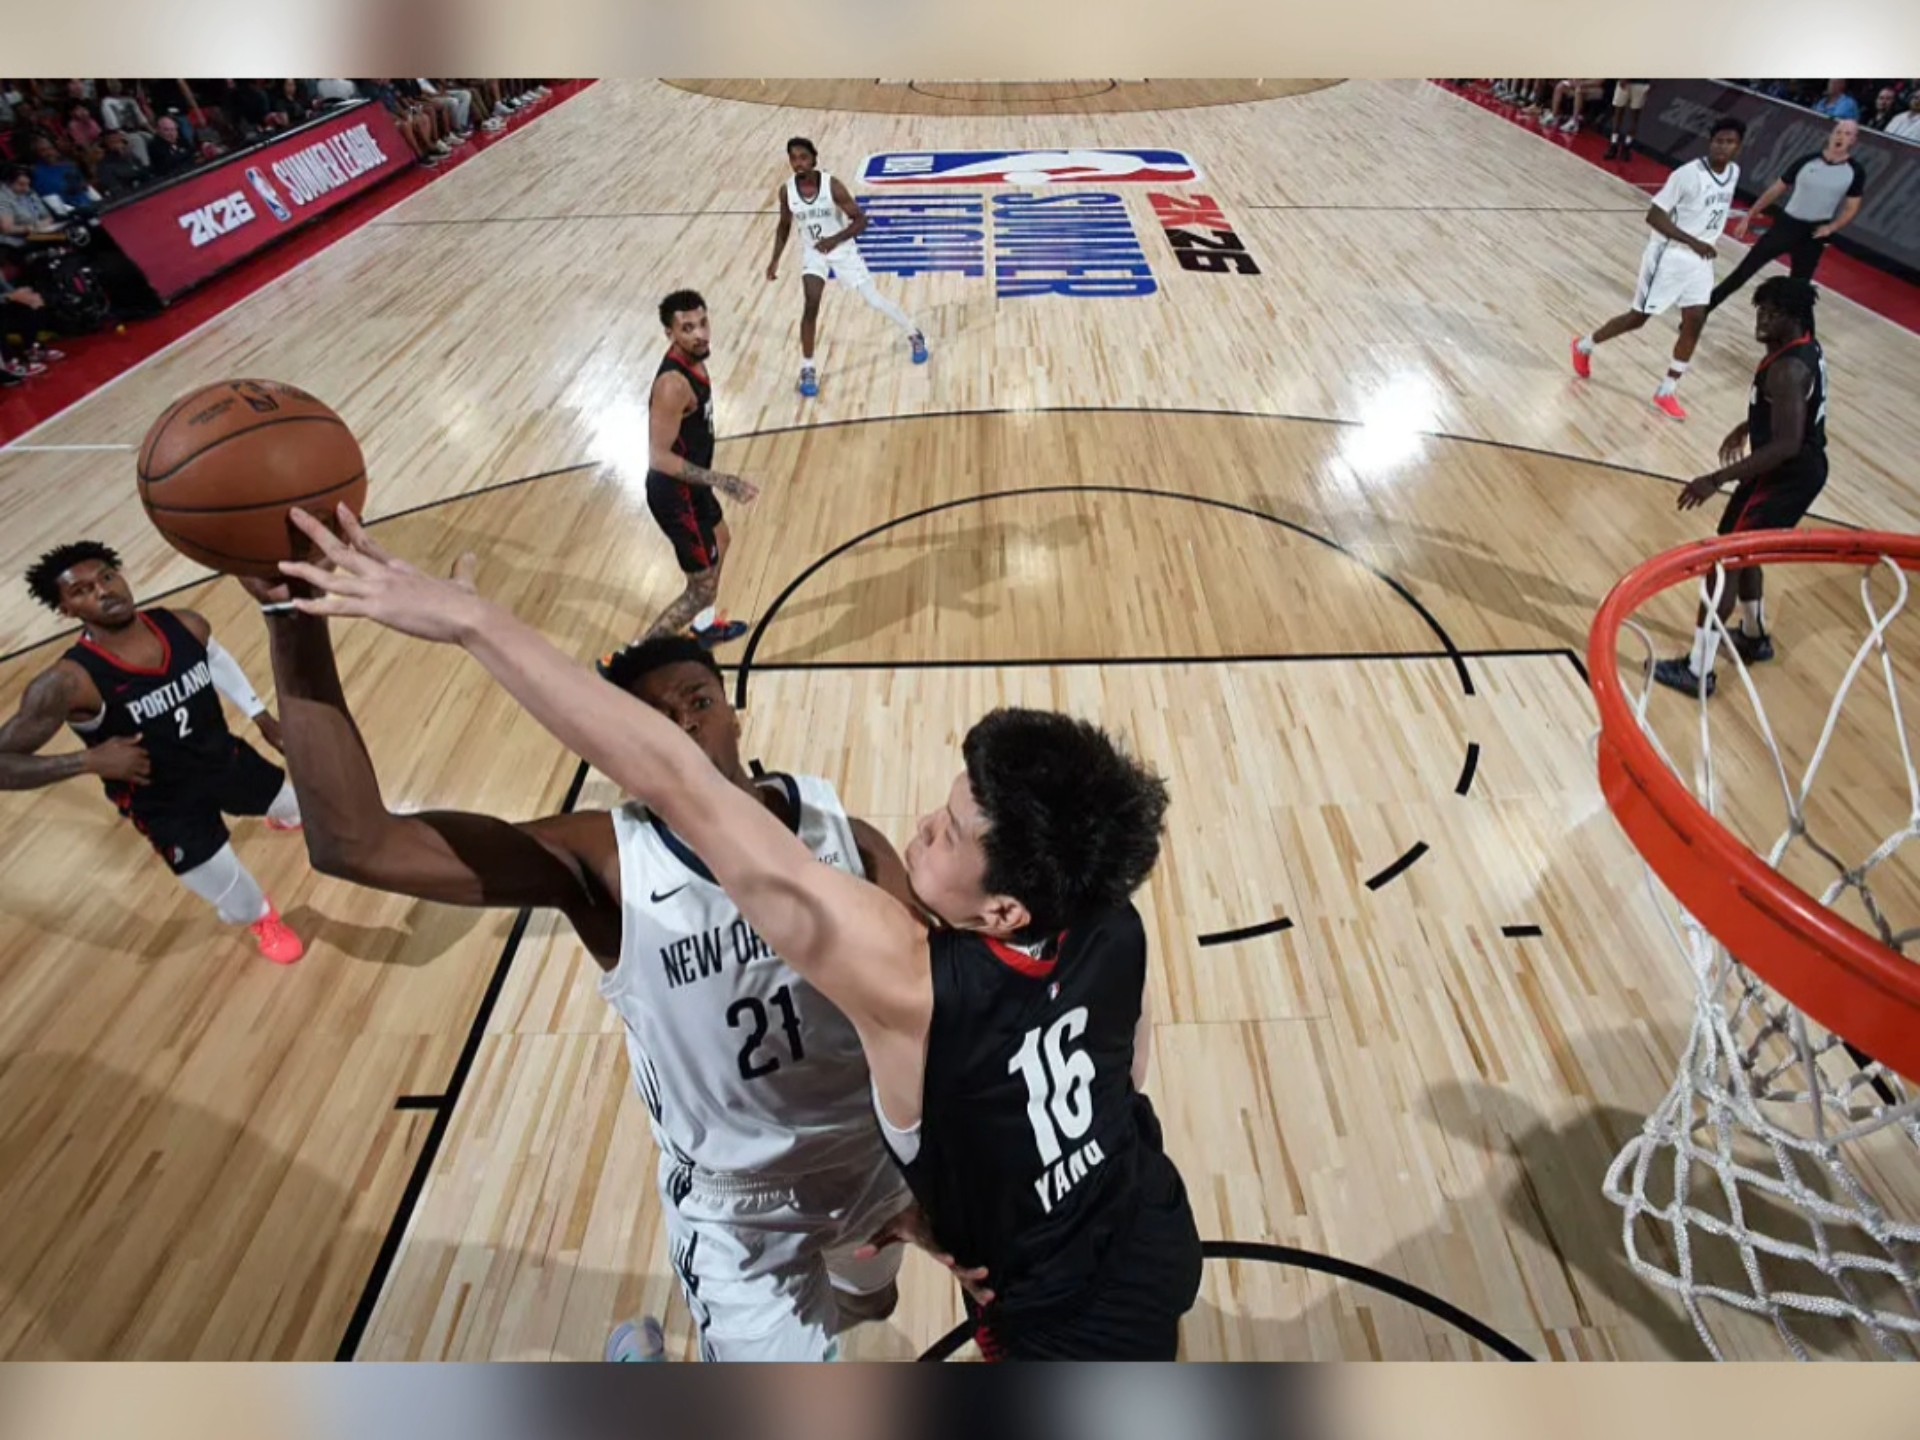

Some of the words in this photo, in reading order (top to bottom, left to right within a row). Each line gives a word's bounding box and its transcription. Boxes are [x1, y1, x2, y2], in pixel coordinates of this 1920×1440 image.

[178, 191, 256, 247] 2K26
[271, 142, 349, 206] SUMMER
[326, 123, 388, 179] LEAGUE
[854, 193, 983, 277] LEAGUE
[991, 192, 1158, 298] SUMMER
[1146, 193, 1262, 275] 2K26
[125, 660, 211, 725] PORTLAND
[174, 706, 193, 738] 2
[659, 926, 722, 989] NEW
[726, 984, 804, 1080] 21
[1008, 1006, 1096, 1167] 16
